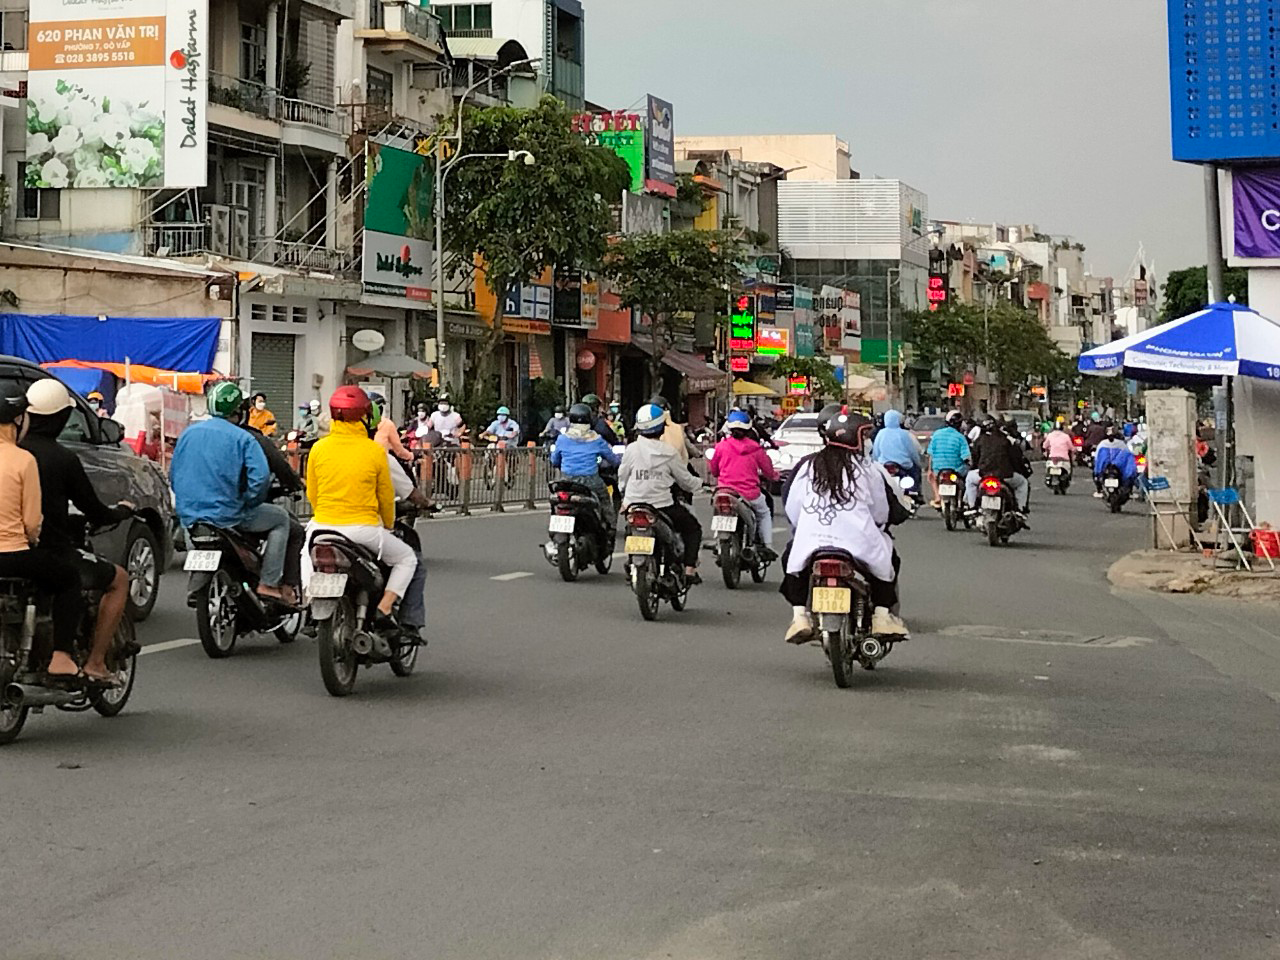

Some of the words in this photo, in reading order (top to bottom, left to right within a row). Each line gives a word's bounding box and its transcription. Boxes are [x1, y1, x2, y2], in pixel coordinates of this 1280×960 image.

[36, 31, 62, 43] 620
[64, 27, 103, 41] PHAN
[106, 25, 136, 40] VĂN
[138, 24, 160, 41] TRỊ
[179, 8, 202, 92] Hasfarms
[66, 52, 84, 63] 028
[85, 51, 110, 63] 3895
[111, 50, 135, 62] 5518
[180, 98, 198, 150] Dalat
